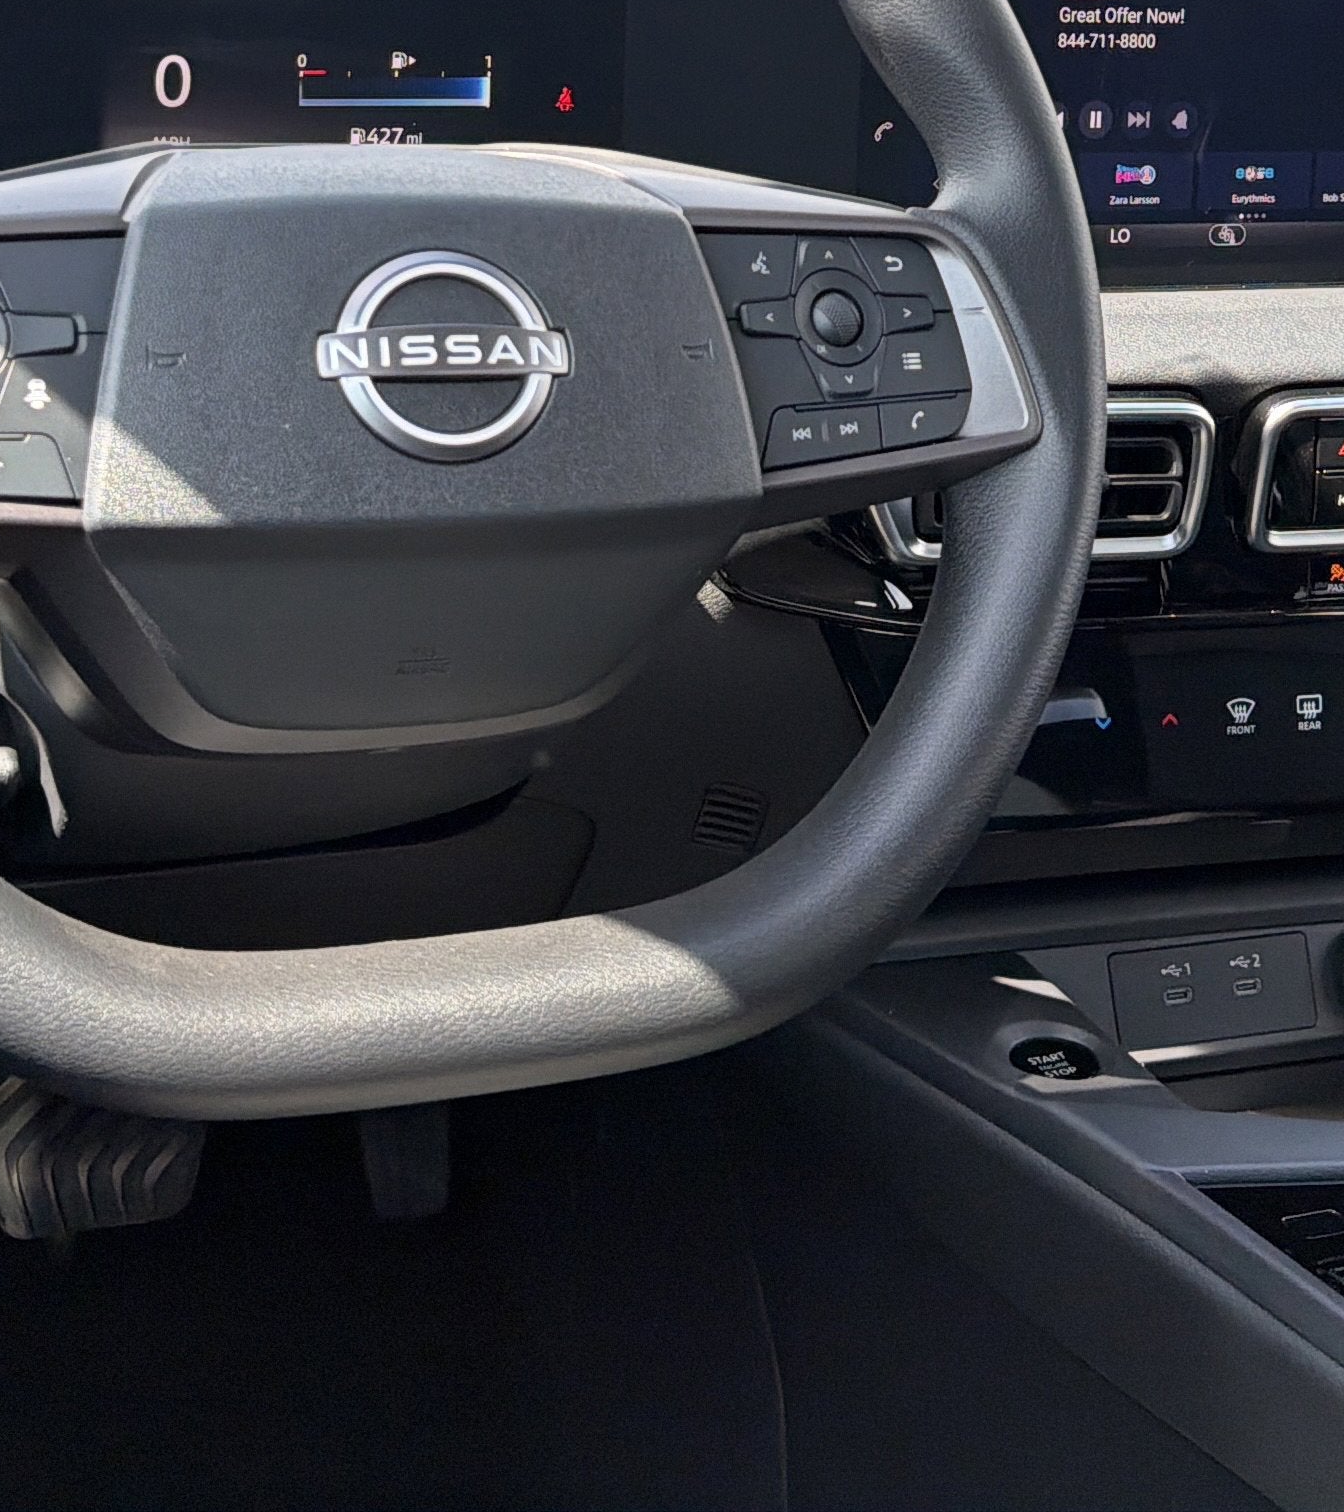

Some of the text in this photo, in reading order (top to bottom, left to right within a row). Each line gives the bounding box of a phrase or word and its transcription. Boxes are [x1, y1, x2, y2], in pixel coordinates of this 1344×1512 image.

[1059, 7, 1185, 24] Great Offer Now!
[1058, 33, 1156, 49] 844-711-8800
[297, 54, 307, 67] 0
[484, 55, 491, 68] 1
[155, 54, 191, 107] 0
[366, 127, 422, 144] 427 mi
[1109, 195, 1160, 205] Zara Larsson
[1232, 194, 1276, 205] Eurythmics
[1323, 193, 1338, 202] Bob
[1110, 228, 1131, 244] LO
[329, 334, 562, 369] NISSAN
[1227, 725, 1256, 735] FRONT
[1298, 721, 1322, 730] REAR
[1184, 954, 1261, 975] 1 2
[1027, 1051, 1065, 1065] START
[1044, 1066, 1077, 1077] STOP
